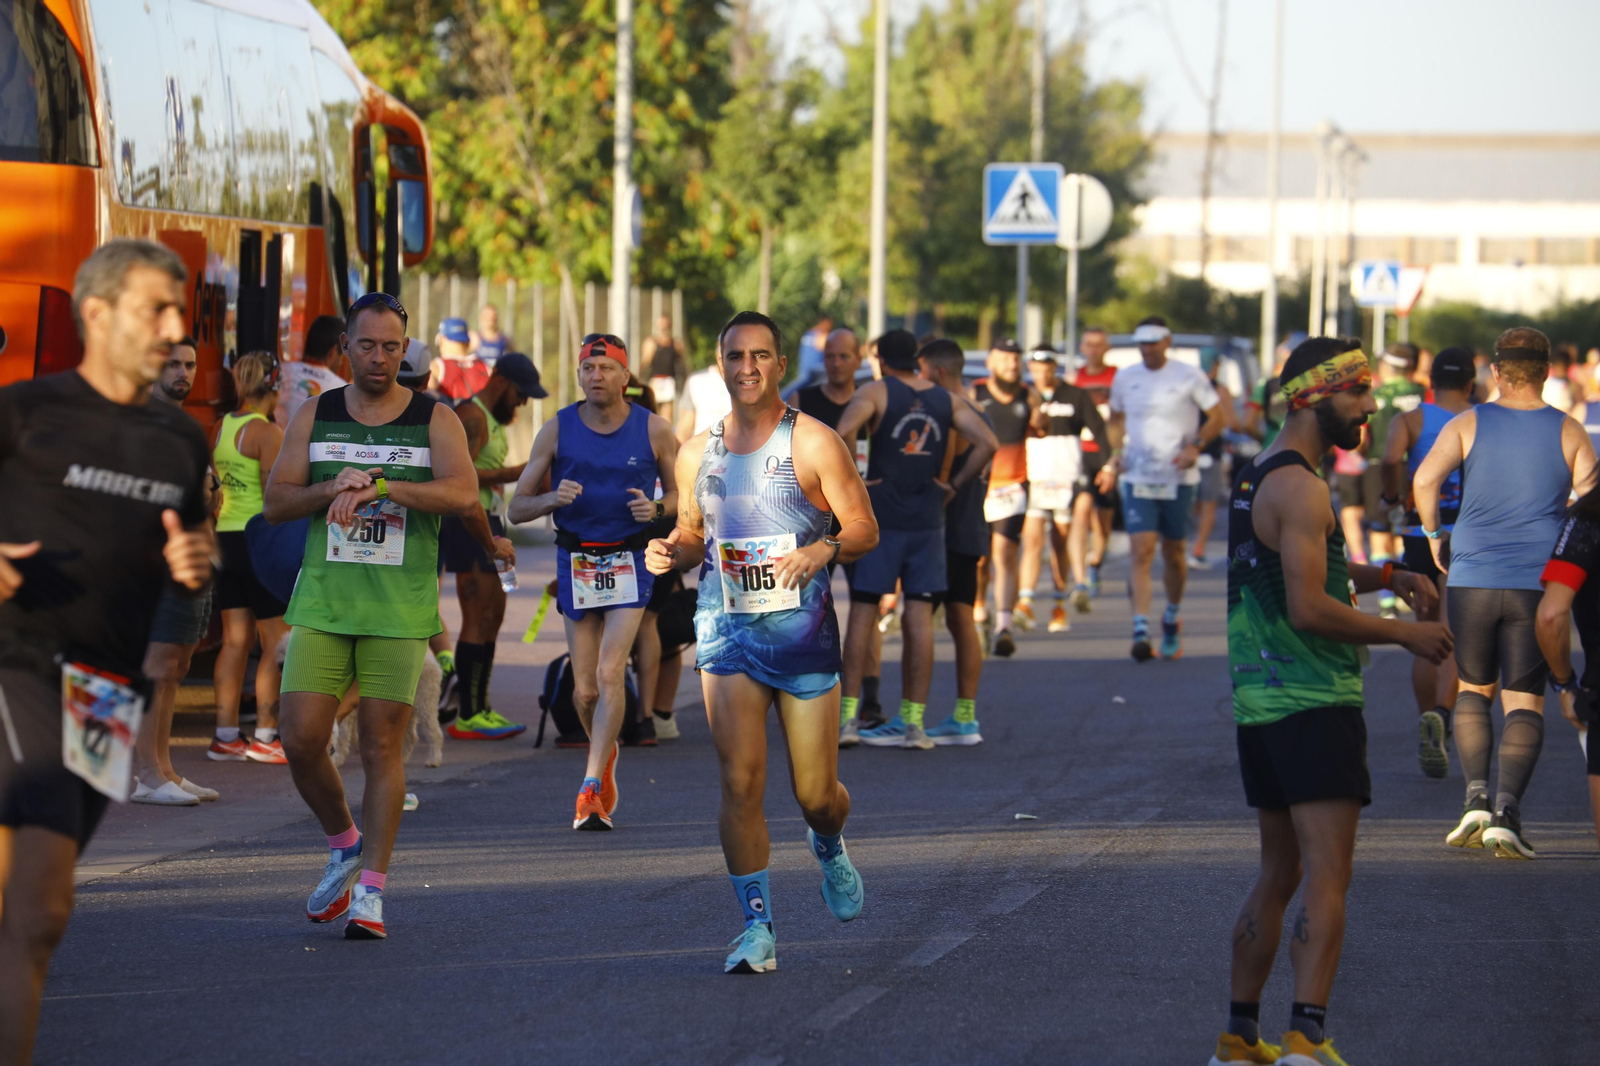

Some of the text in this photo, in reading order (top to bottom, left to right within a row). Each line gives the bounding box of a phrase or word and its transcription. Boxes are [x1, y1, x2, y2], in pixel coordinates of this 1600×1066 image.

[347, 518, 386, 544] 250
[595, 572, 616, 590] 96
[740, 564, 776, 592] 105
